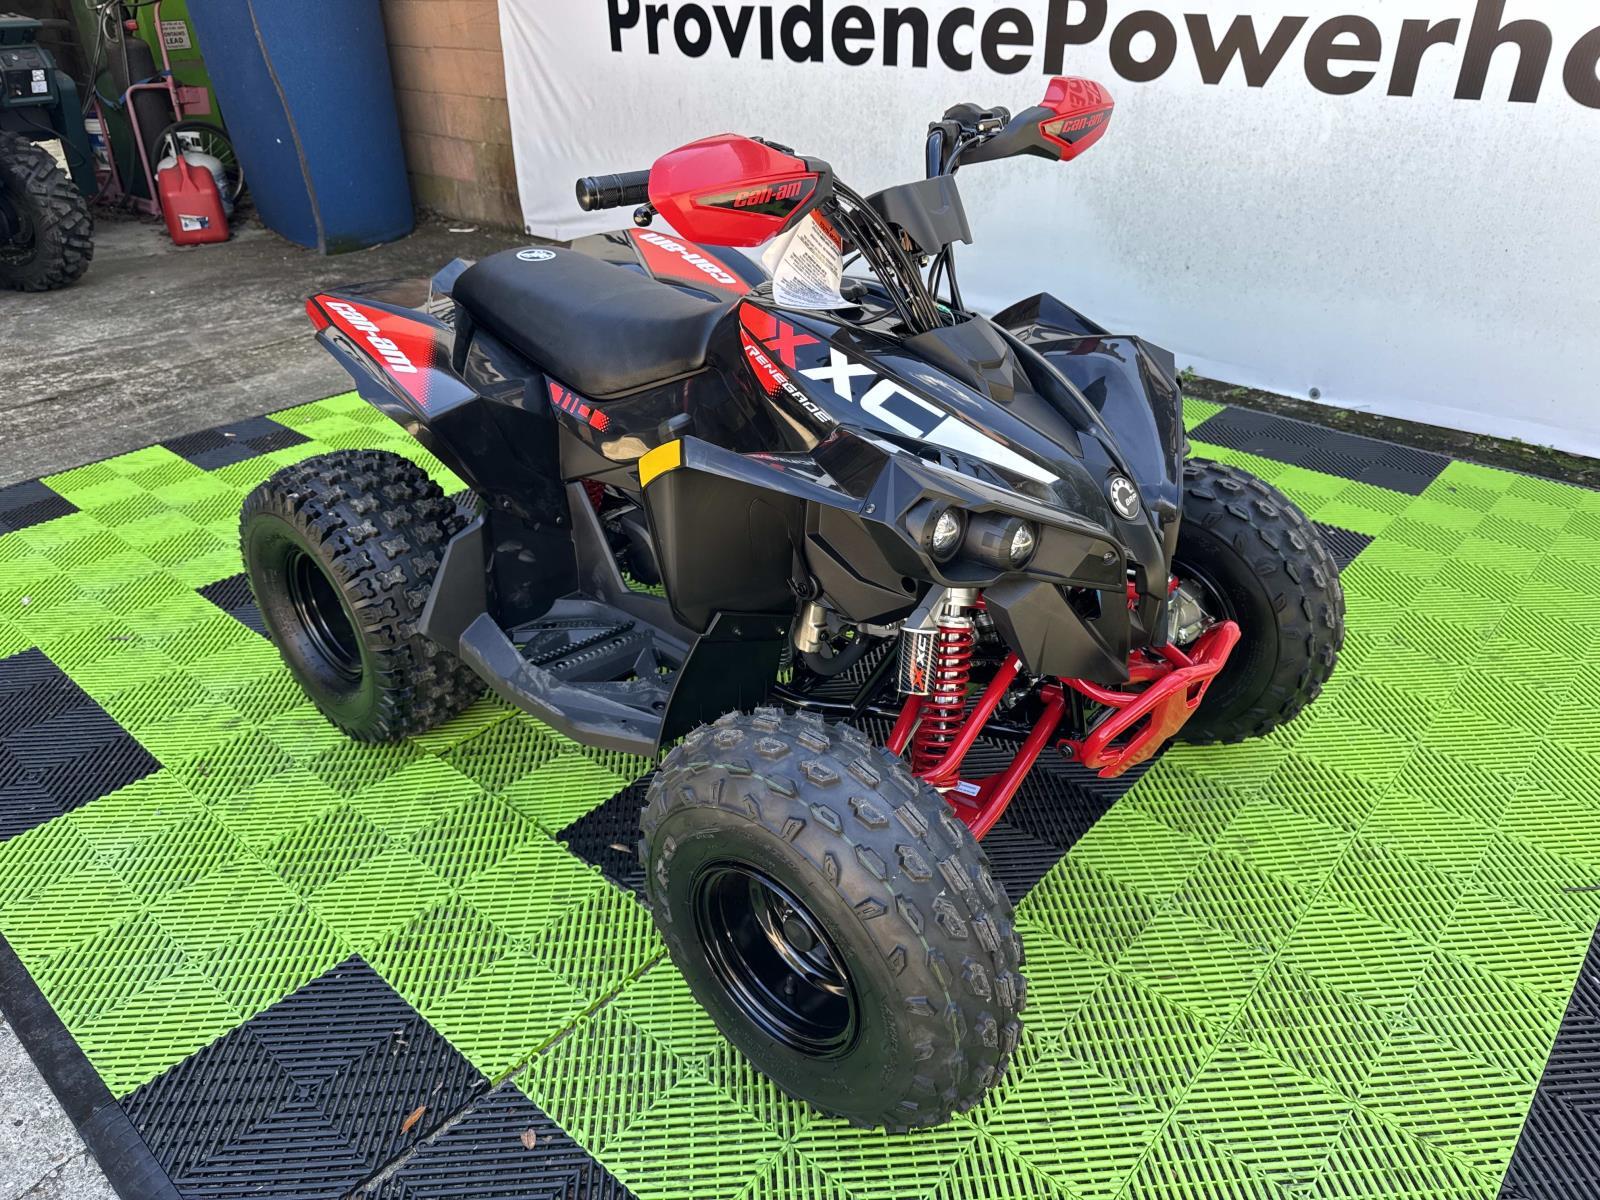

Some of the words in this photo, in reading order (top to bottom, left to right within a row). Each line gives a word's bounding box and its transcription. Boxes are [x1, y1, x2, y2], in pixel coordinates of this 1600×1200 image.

[166, 37, 184, 45] LEAD
[1062, 112, 1104, 133] can-am
[733, 181, 802, 208] can-am
[639, 233, 737, 284] can-am
[325, 301, 418, 374] can-am
[744, 344, 831, 423] RENEGADE
[1125, 492, 1137, 507] BRP
